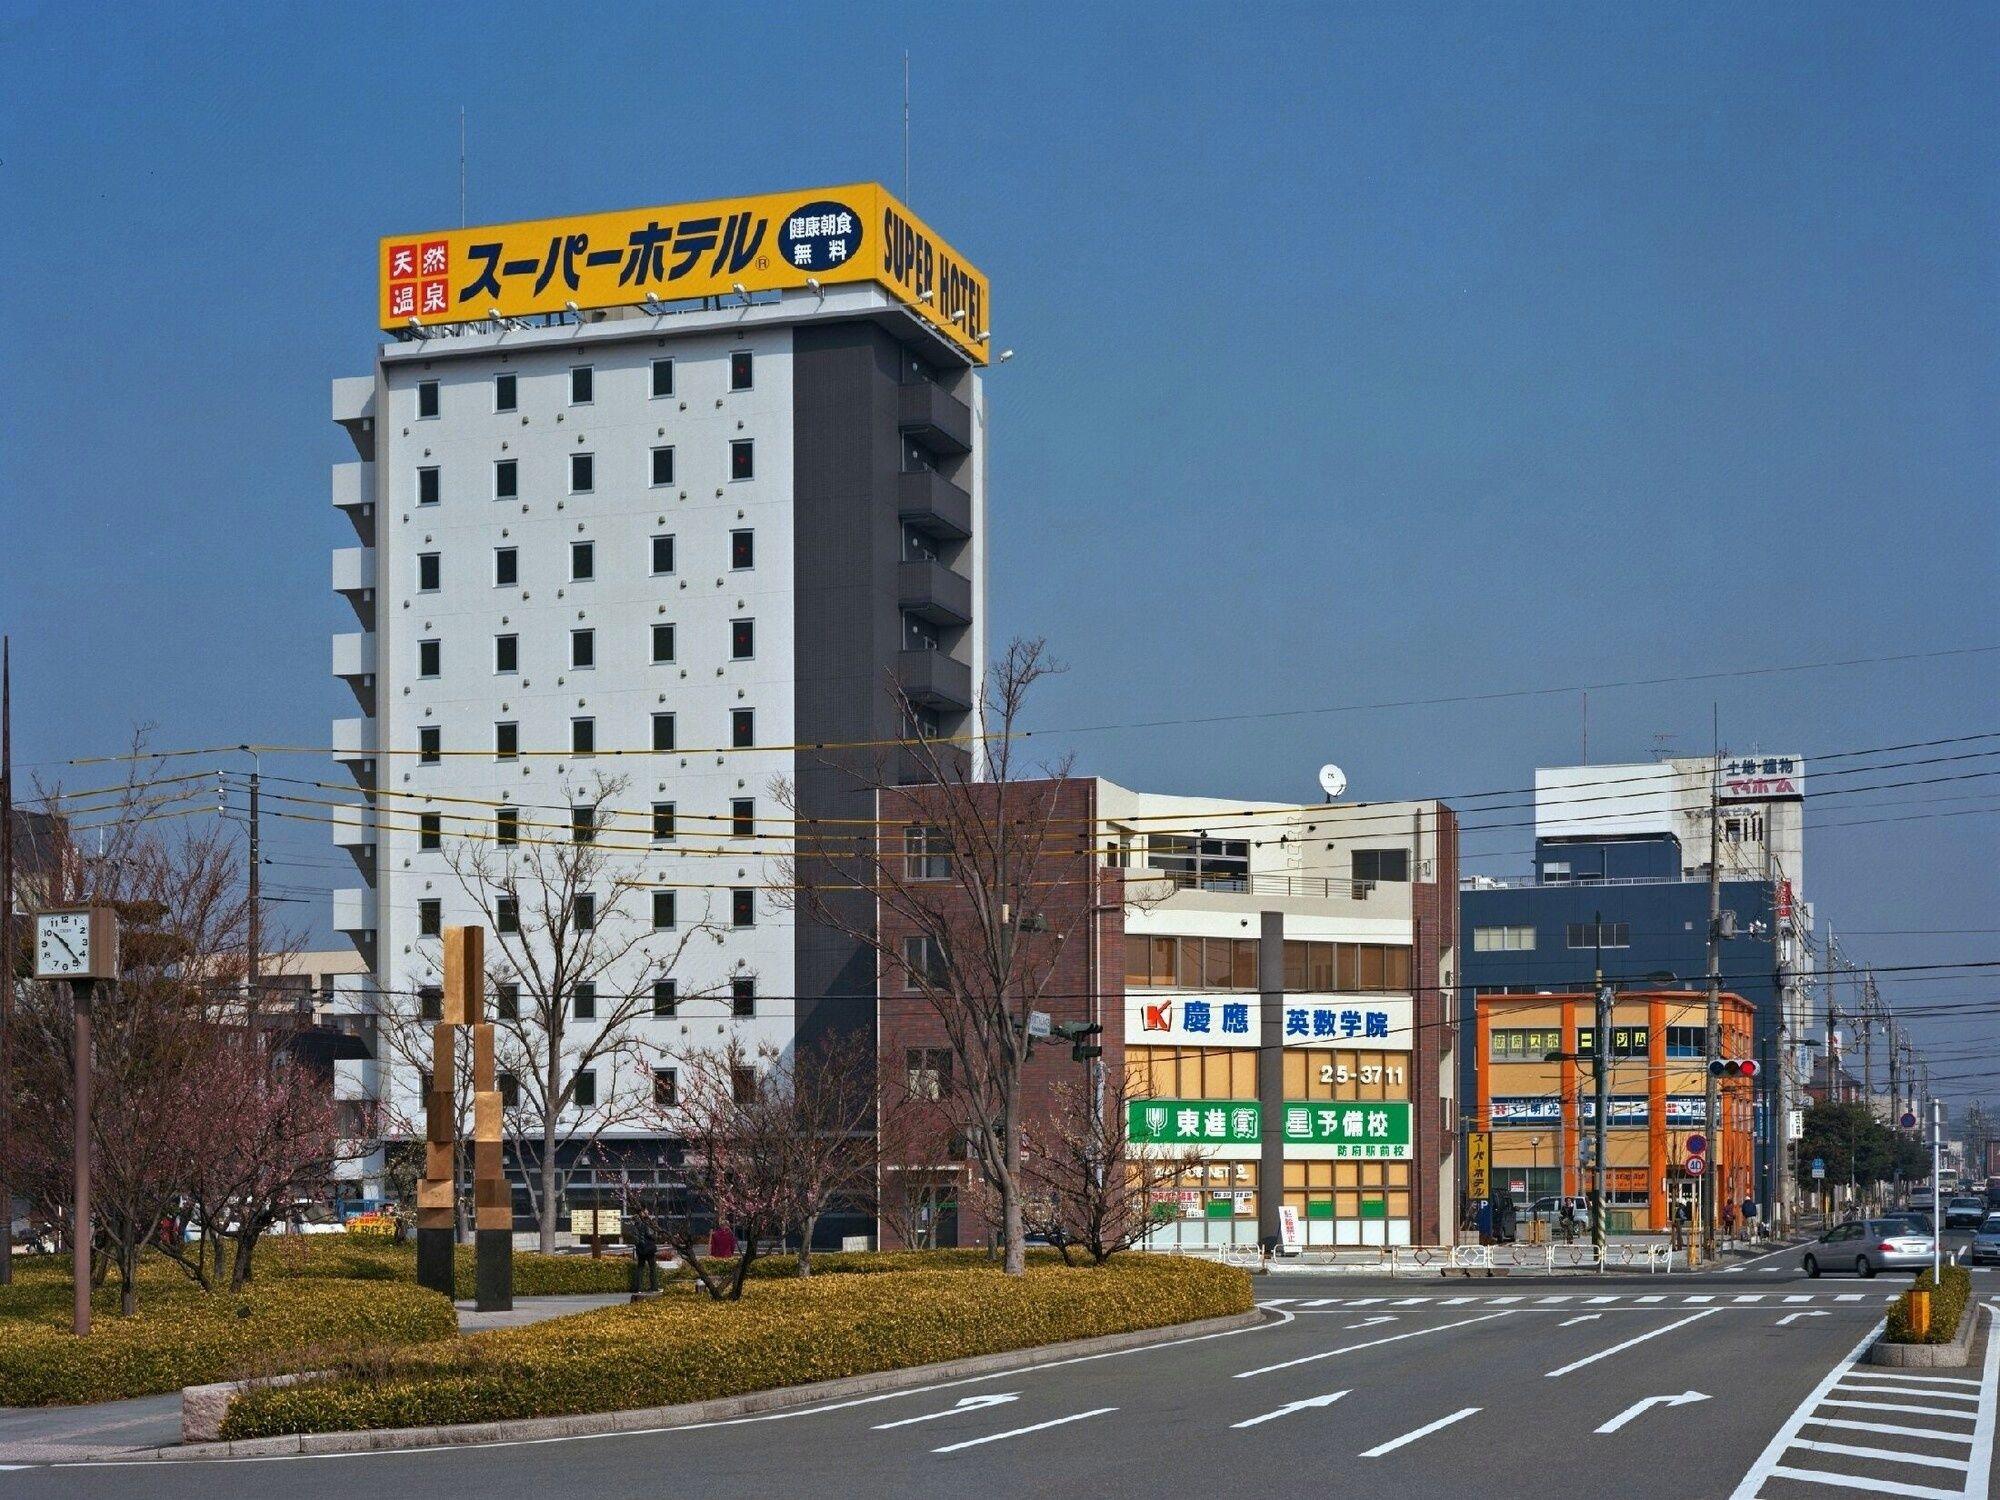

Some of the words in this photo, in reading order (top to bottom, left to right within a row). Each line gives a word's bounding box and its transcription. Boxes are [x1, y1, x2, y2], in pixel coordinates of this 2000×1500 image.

[789, 212, 852, 240] 健康朝食
[393, 245, 446, 277] 天然
[459, 212, 768, 303] スーパーホテル
[794, 239, 847, 265] 無料
[884, 206, 934, 308] SUPER
[939, 252, 984, 347] HOTEL
[393, 283, 446, 315] 温泉
[62, 963, 69, 971] 6
[1183, 1001, 1249, 1033] 慶應
[1286, 1009, 1389, 1038] 英数学院
[1320, 1064, 1403, 1084] 25-3711
[1176, 1108, 1258, 1138] 東進衛
[1286, 1108, 1389, 1139] 星予備校
[1337, 1145, 1405, 1157] 防府駅前校
[1473, 1134, 1485, 1197] スーパーホテル
[1208, 1166, 1231, 1179] NET
